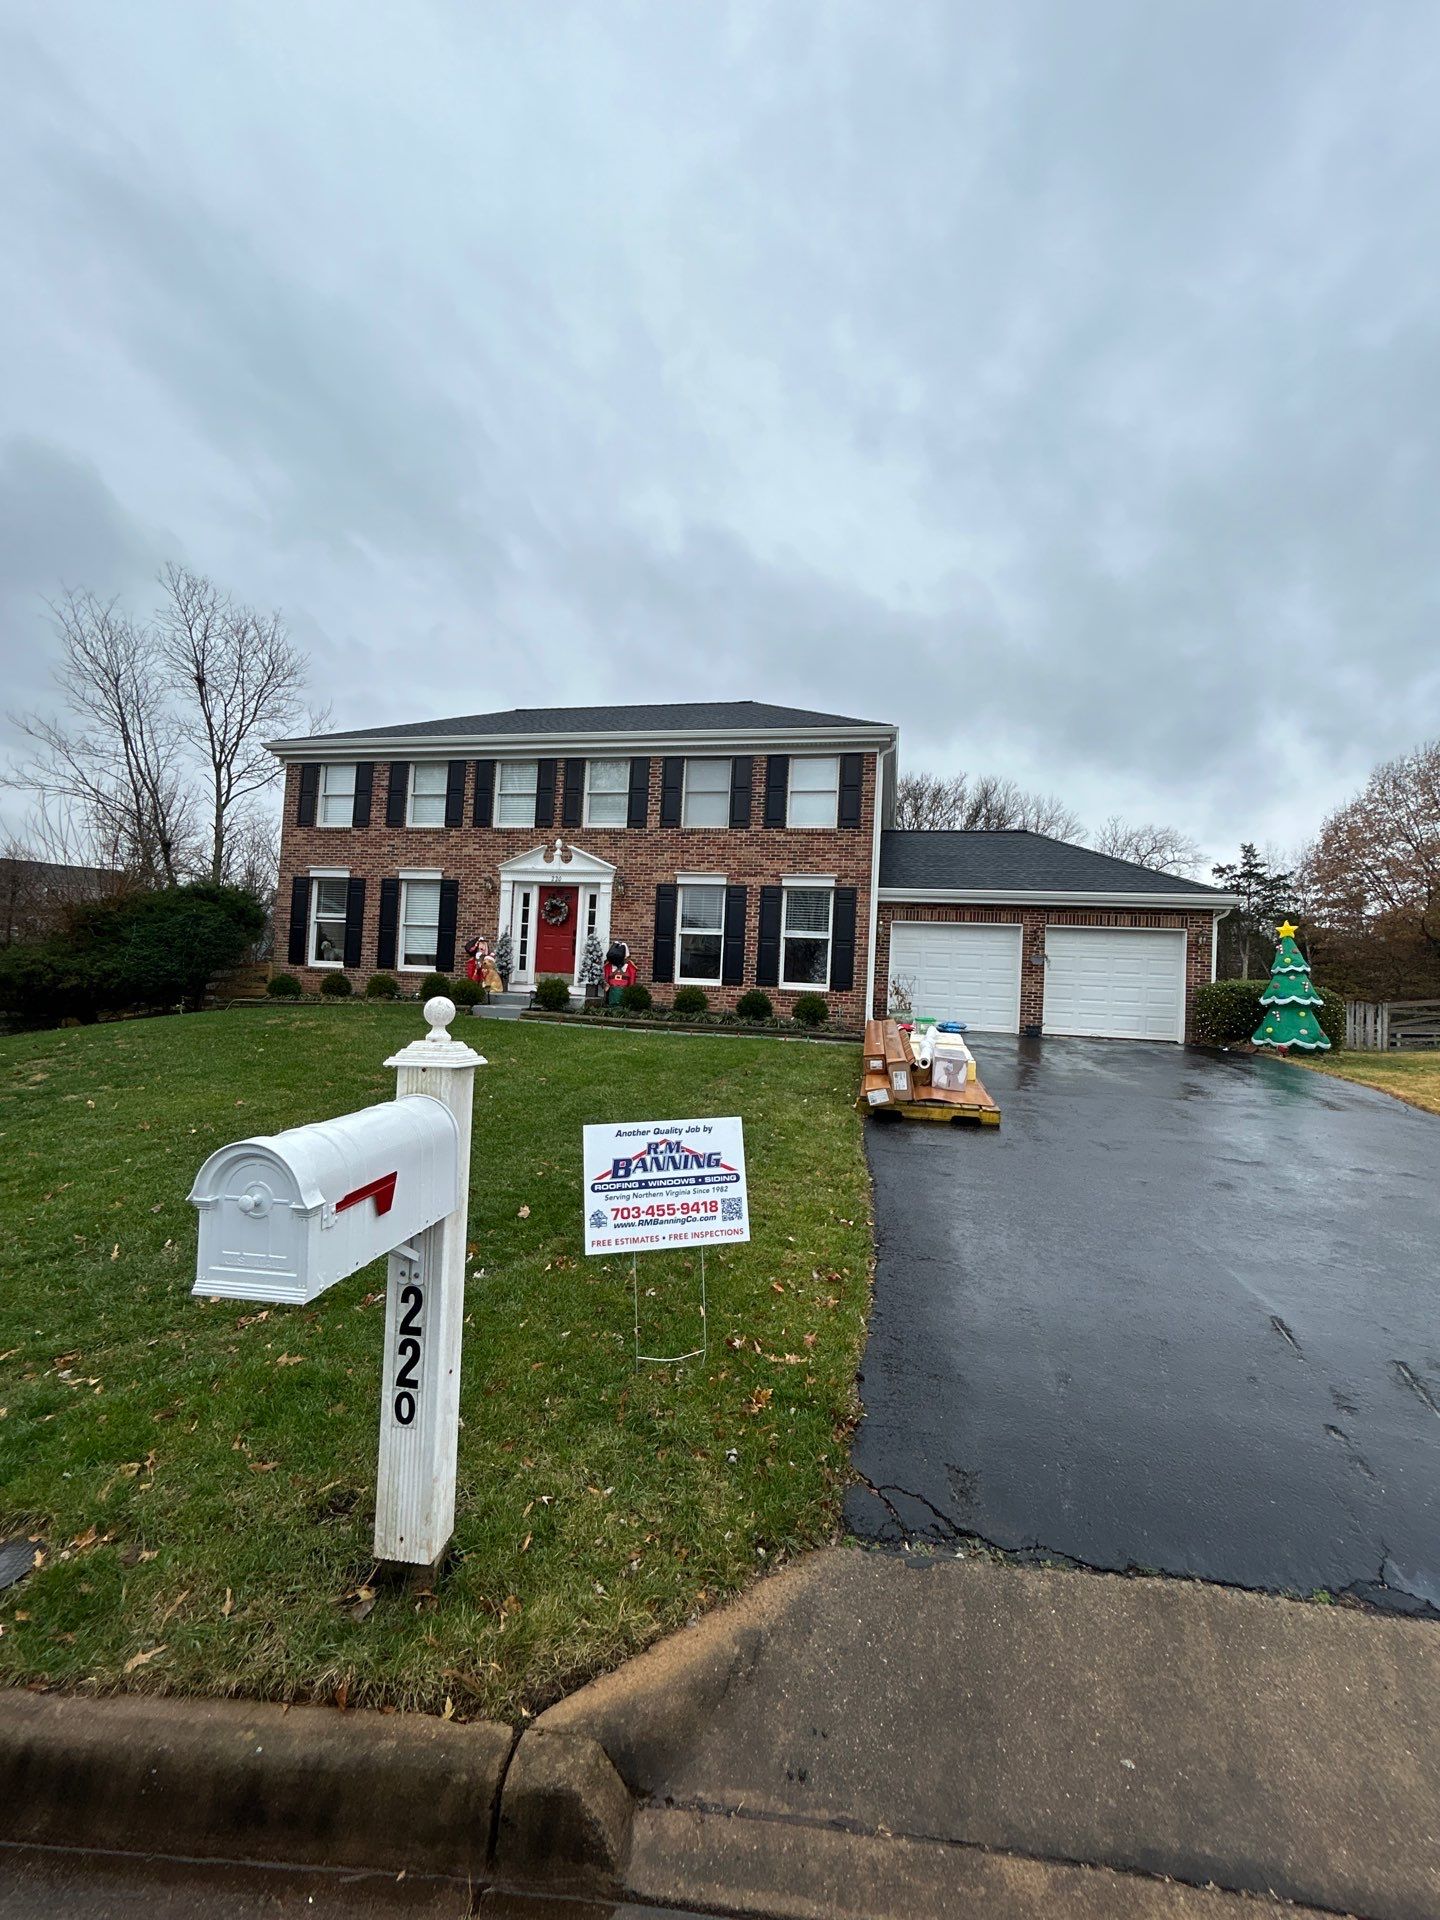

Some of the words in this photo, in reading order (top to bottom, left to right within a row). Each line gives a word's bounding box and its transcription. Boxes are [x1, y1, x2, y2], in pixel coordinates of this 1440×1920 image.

[615, 1129, 651, 1138] Another
[653, 1127, 684, 1136] Quality
[685, 1125, 701, 1134] Job
[702, 1125, 713, 1134] by
[646, 1140, 685, 1155] R.M.
[610, 1152, 722, 1179] BANNING
[594, 1181, 639, 1191] ROOFING
[648, 1177, 696, 1187] WINDOWS
[704, 1175, 737, 1183] SIDING
[604, 1193, 631, 1202] Serving
[632, 1189, 664, 1200] Northern
[665, 1189, 691, 1198] Virginia
[711, 1185, 729, 1194] 1982
[613, 1215, 717, 1229] www.RMBanningCo.com
[591, 1239, 613, 1248] FREE
[615, 1234, 660, 1246] ESTIMATES
[668, 1232, 689, 1241] FREE
[691, 1227, 744, 1239] INSPECTIONS
[394, 1285, 424, 1425] 220
